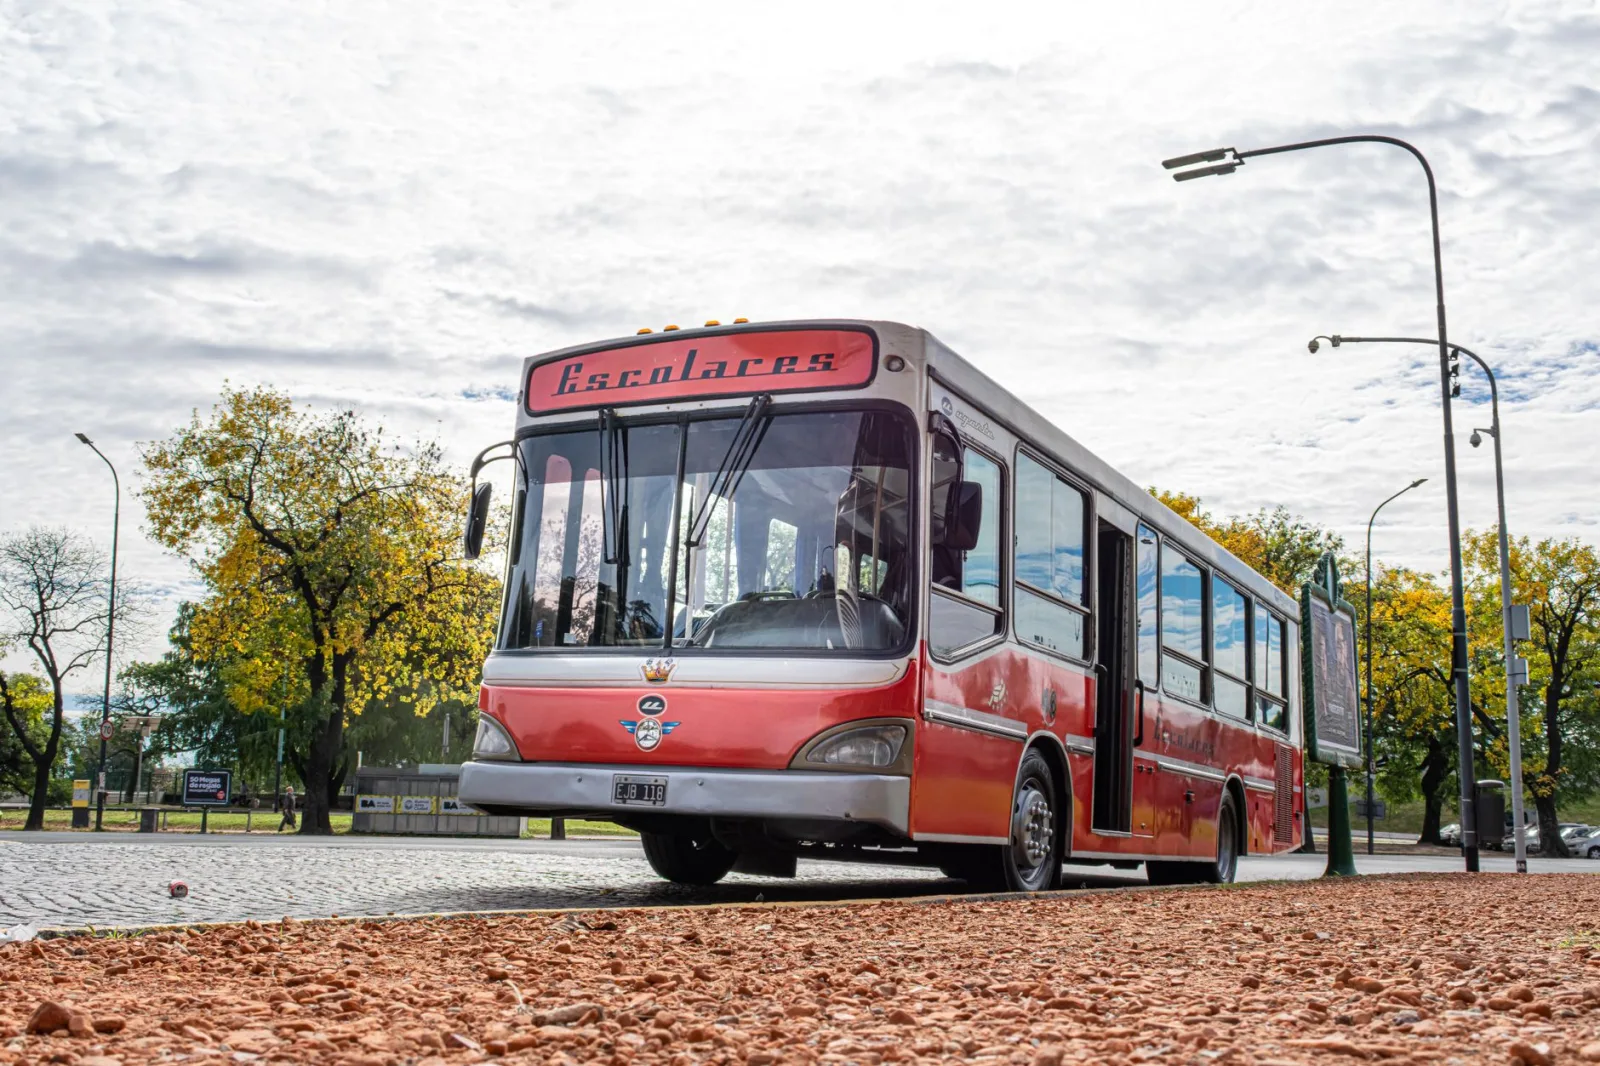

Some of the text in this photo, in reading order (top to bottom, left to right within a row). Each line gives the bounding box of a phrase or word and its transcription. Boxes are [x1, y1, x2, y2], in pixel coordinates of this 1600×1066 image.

[554, 349, 836, 396] Escolares
[104, 726, 112, 734] 70
[643, 785, 664, 801] 118
[361, 799, 376, 808] BA
[443, 801, 459, 810] BA
